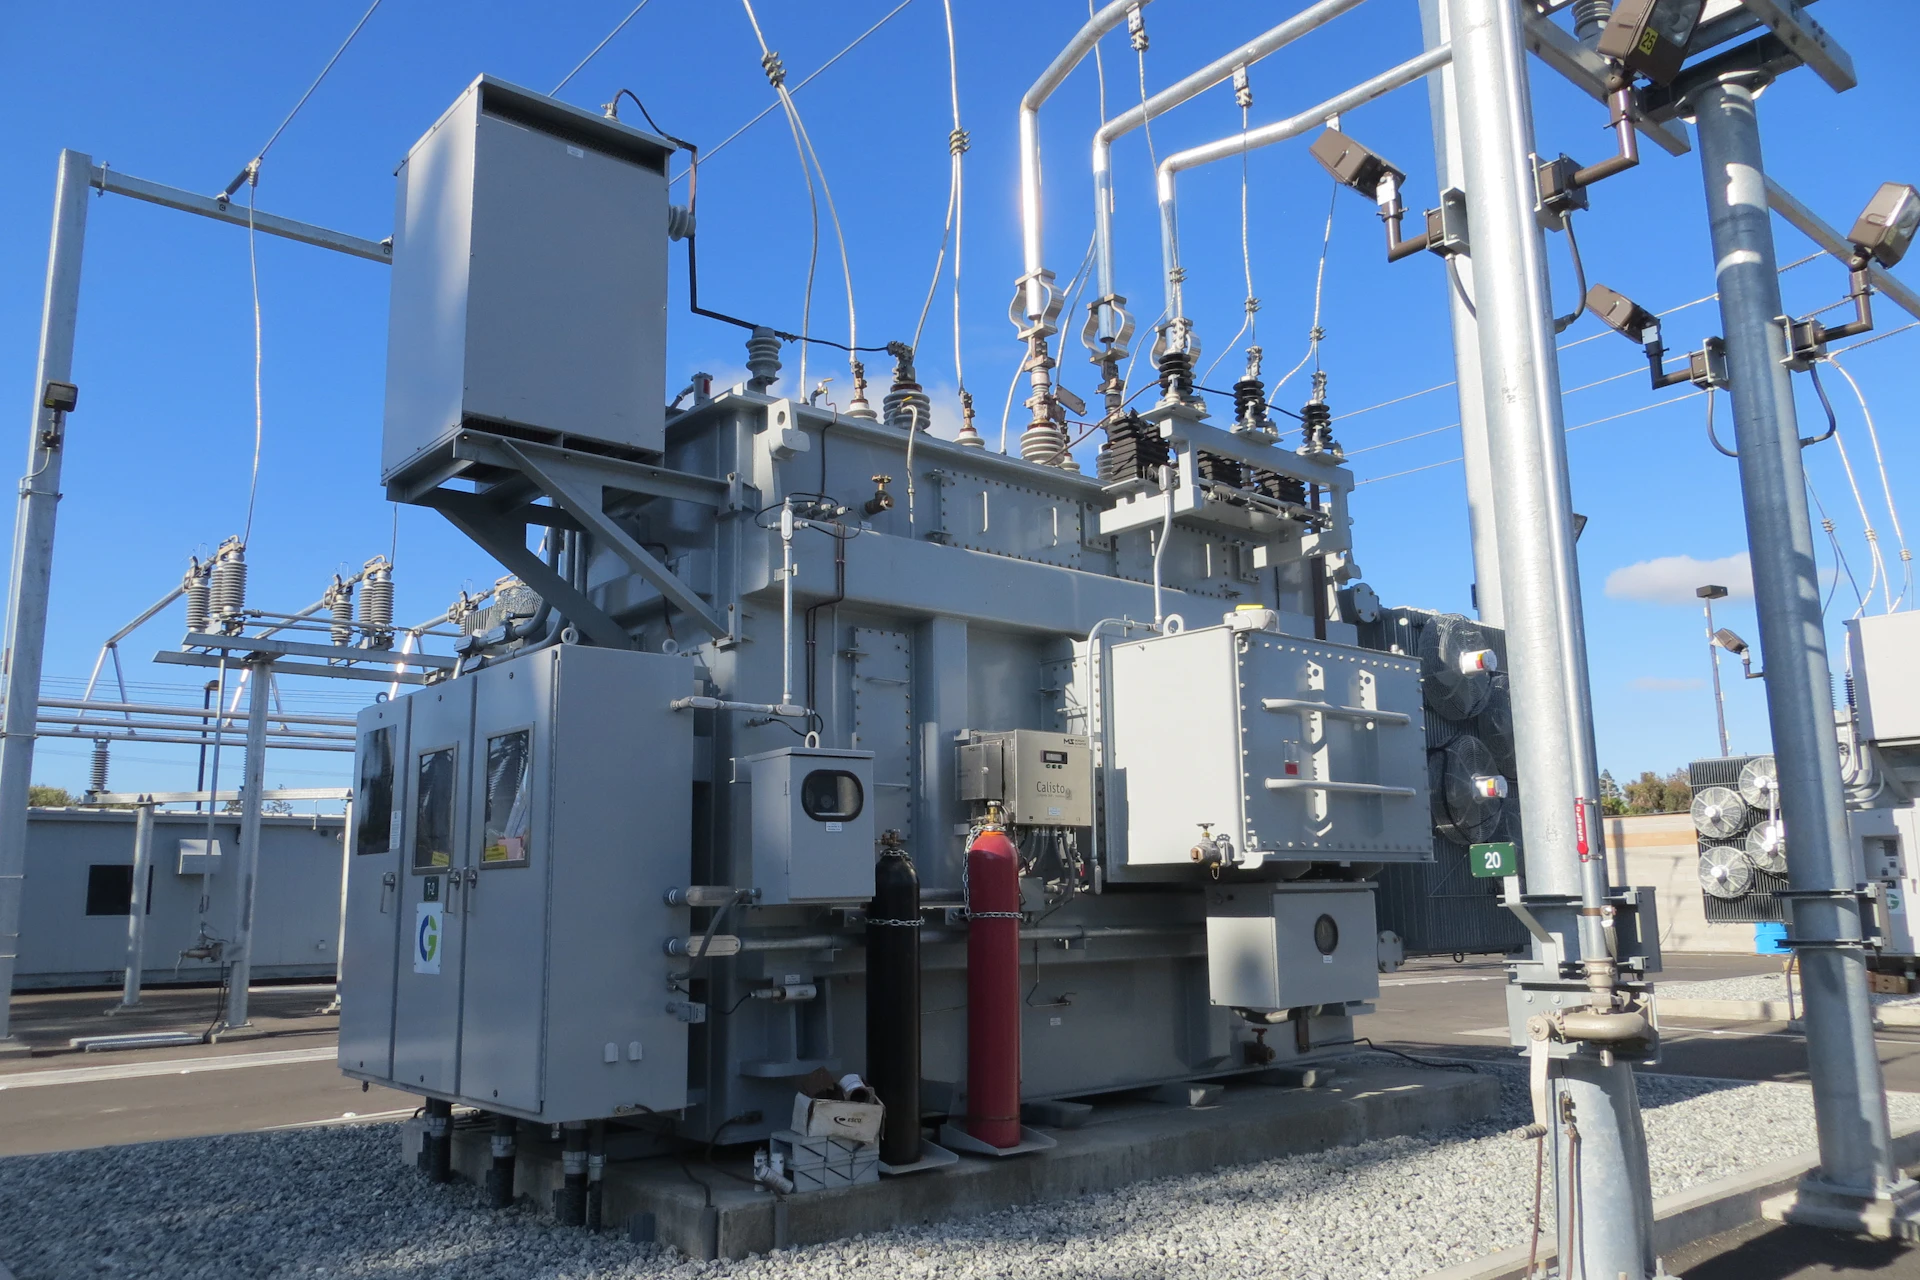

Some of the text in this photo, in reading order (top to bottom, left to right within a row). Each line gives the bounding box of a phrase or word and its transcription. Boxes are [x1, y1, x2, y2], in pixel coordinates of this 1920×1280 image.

[1641, 31, 1656, 50] 25
[1036, 781, 1065, 794] Calisto
[1484, 851, 1501, 869] 20
